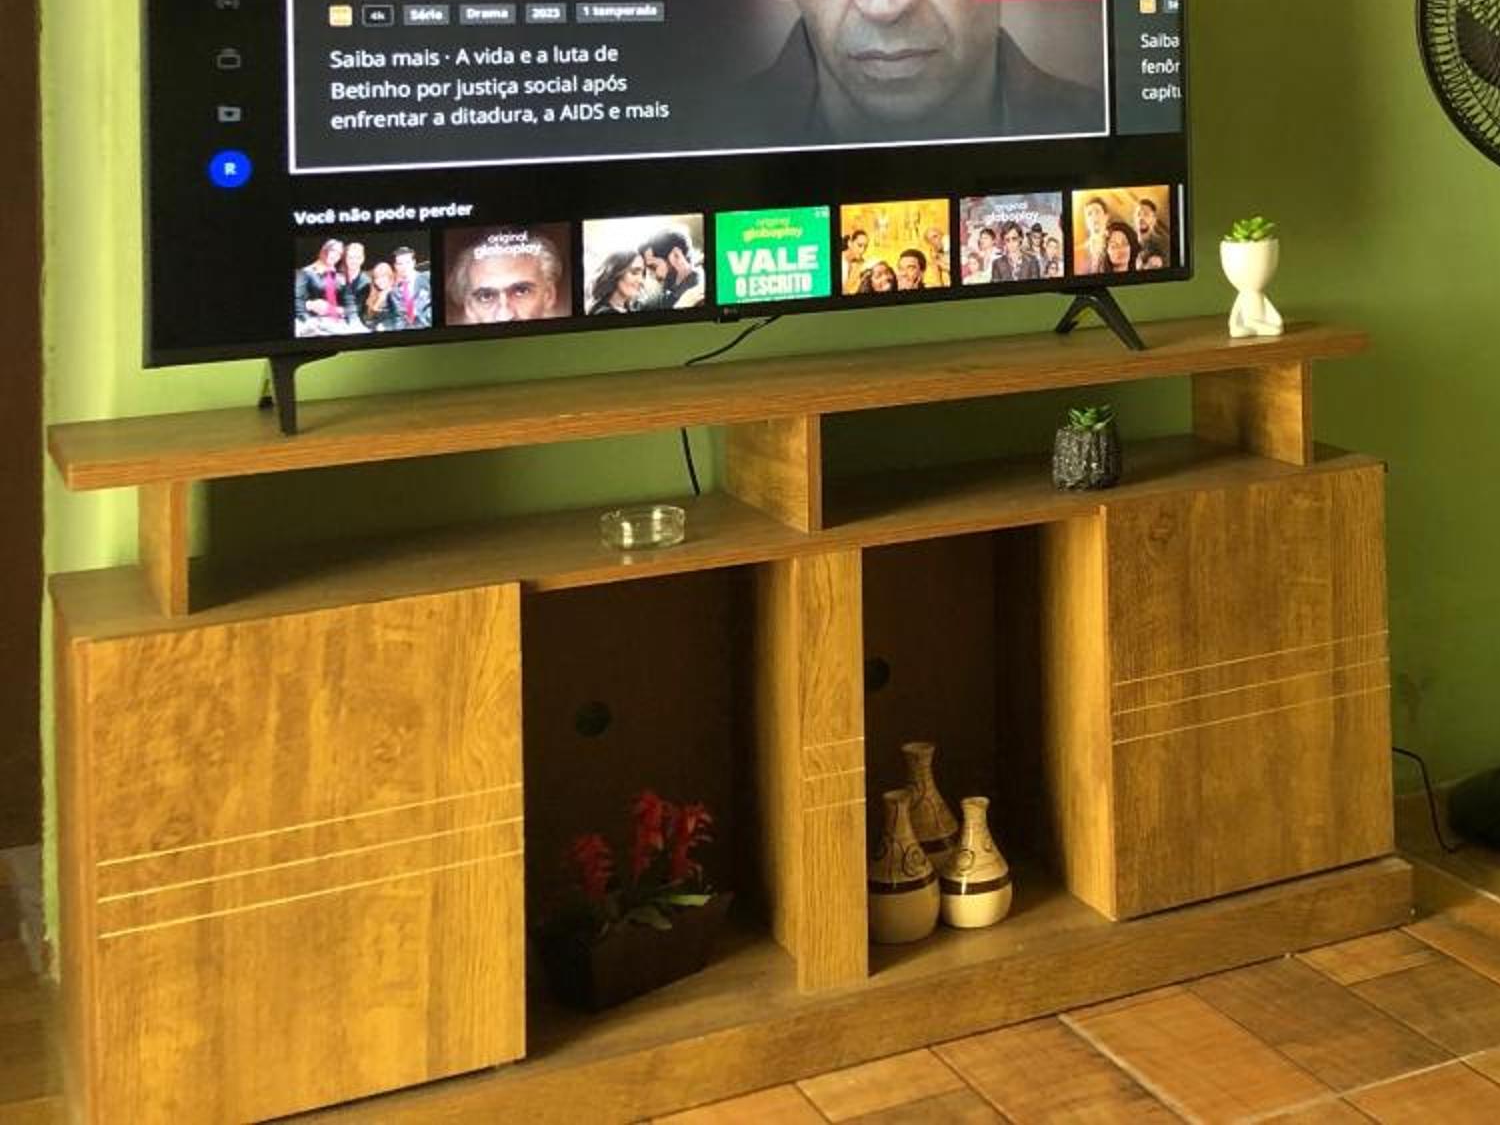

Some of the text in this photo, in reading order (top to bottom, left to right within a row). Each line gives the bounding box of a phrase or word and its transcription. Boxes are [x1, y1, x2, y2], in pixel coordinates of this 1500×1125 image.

[409, 7, 444, 22] Série
[466, 7, 510, 21] Drama
[531, 7, 561, 20] 2023
[592, 3, 658, 21] temporada
[1140, 32, 1180, 49] Saiba
[328, 44, 620, 69] Saiba mais A vida e a luta de
[330, 73, 628, 102] Betinho por justiça social após
[330, 100, 670, 131] enfrentar a ditadura, a AIDS e mais
[224, 161, 238, 176] R
[293, 202, 473, 225] Você não pode perder
[487, 229, 529, 244] original
[473, 242, 543, 259] globoplay
[726, 244, 819, 276] VALE
[735, 272, 812, 297] O ESCRITO
